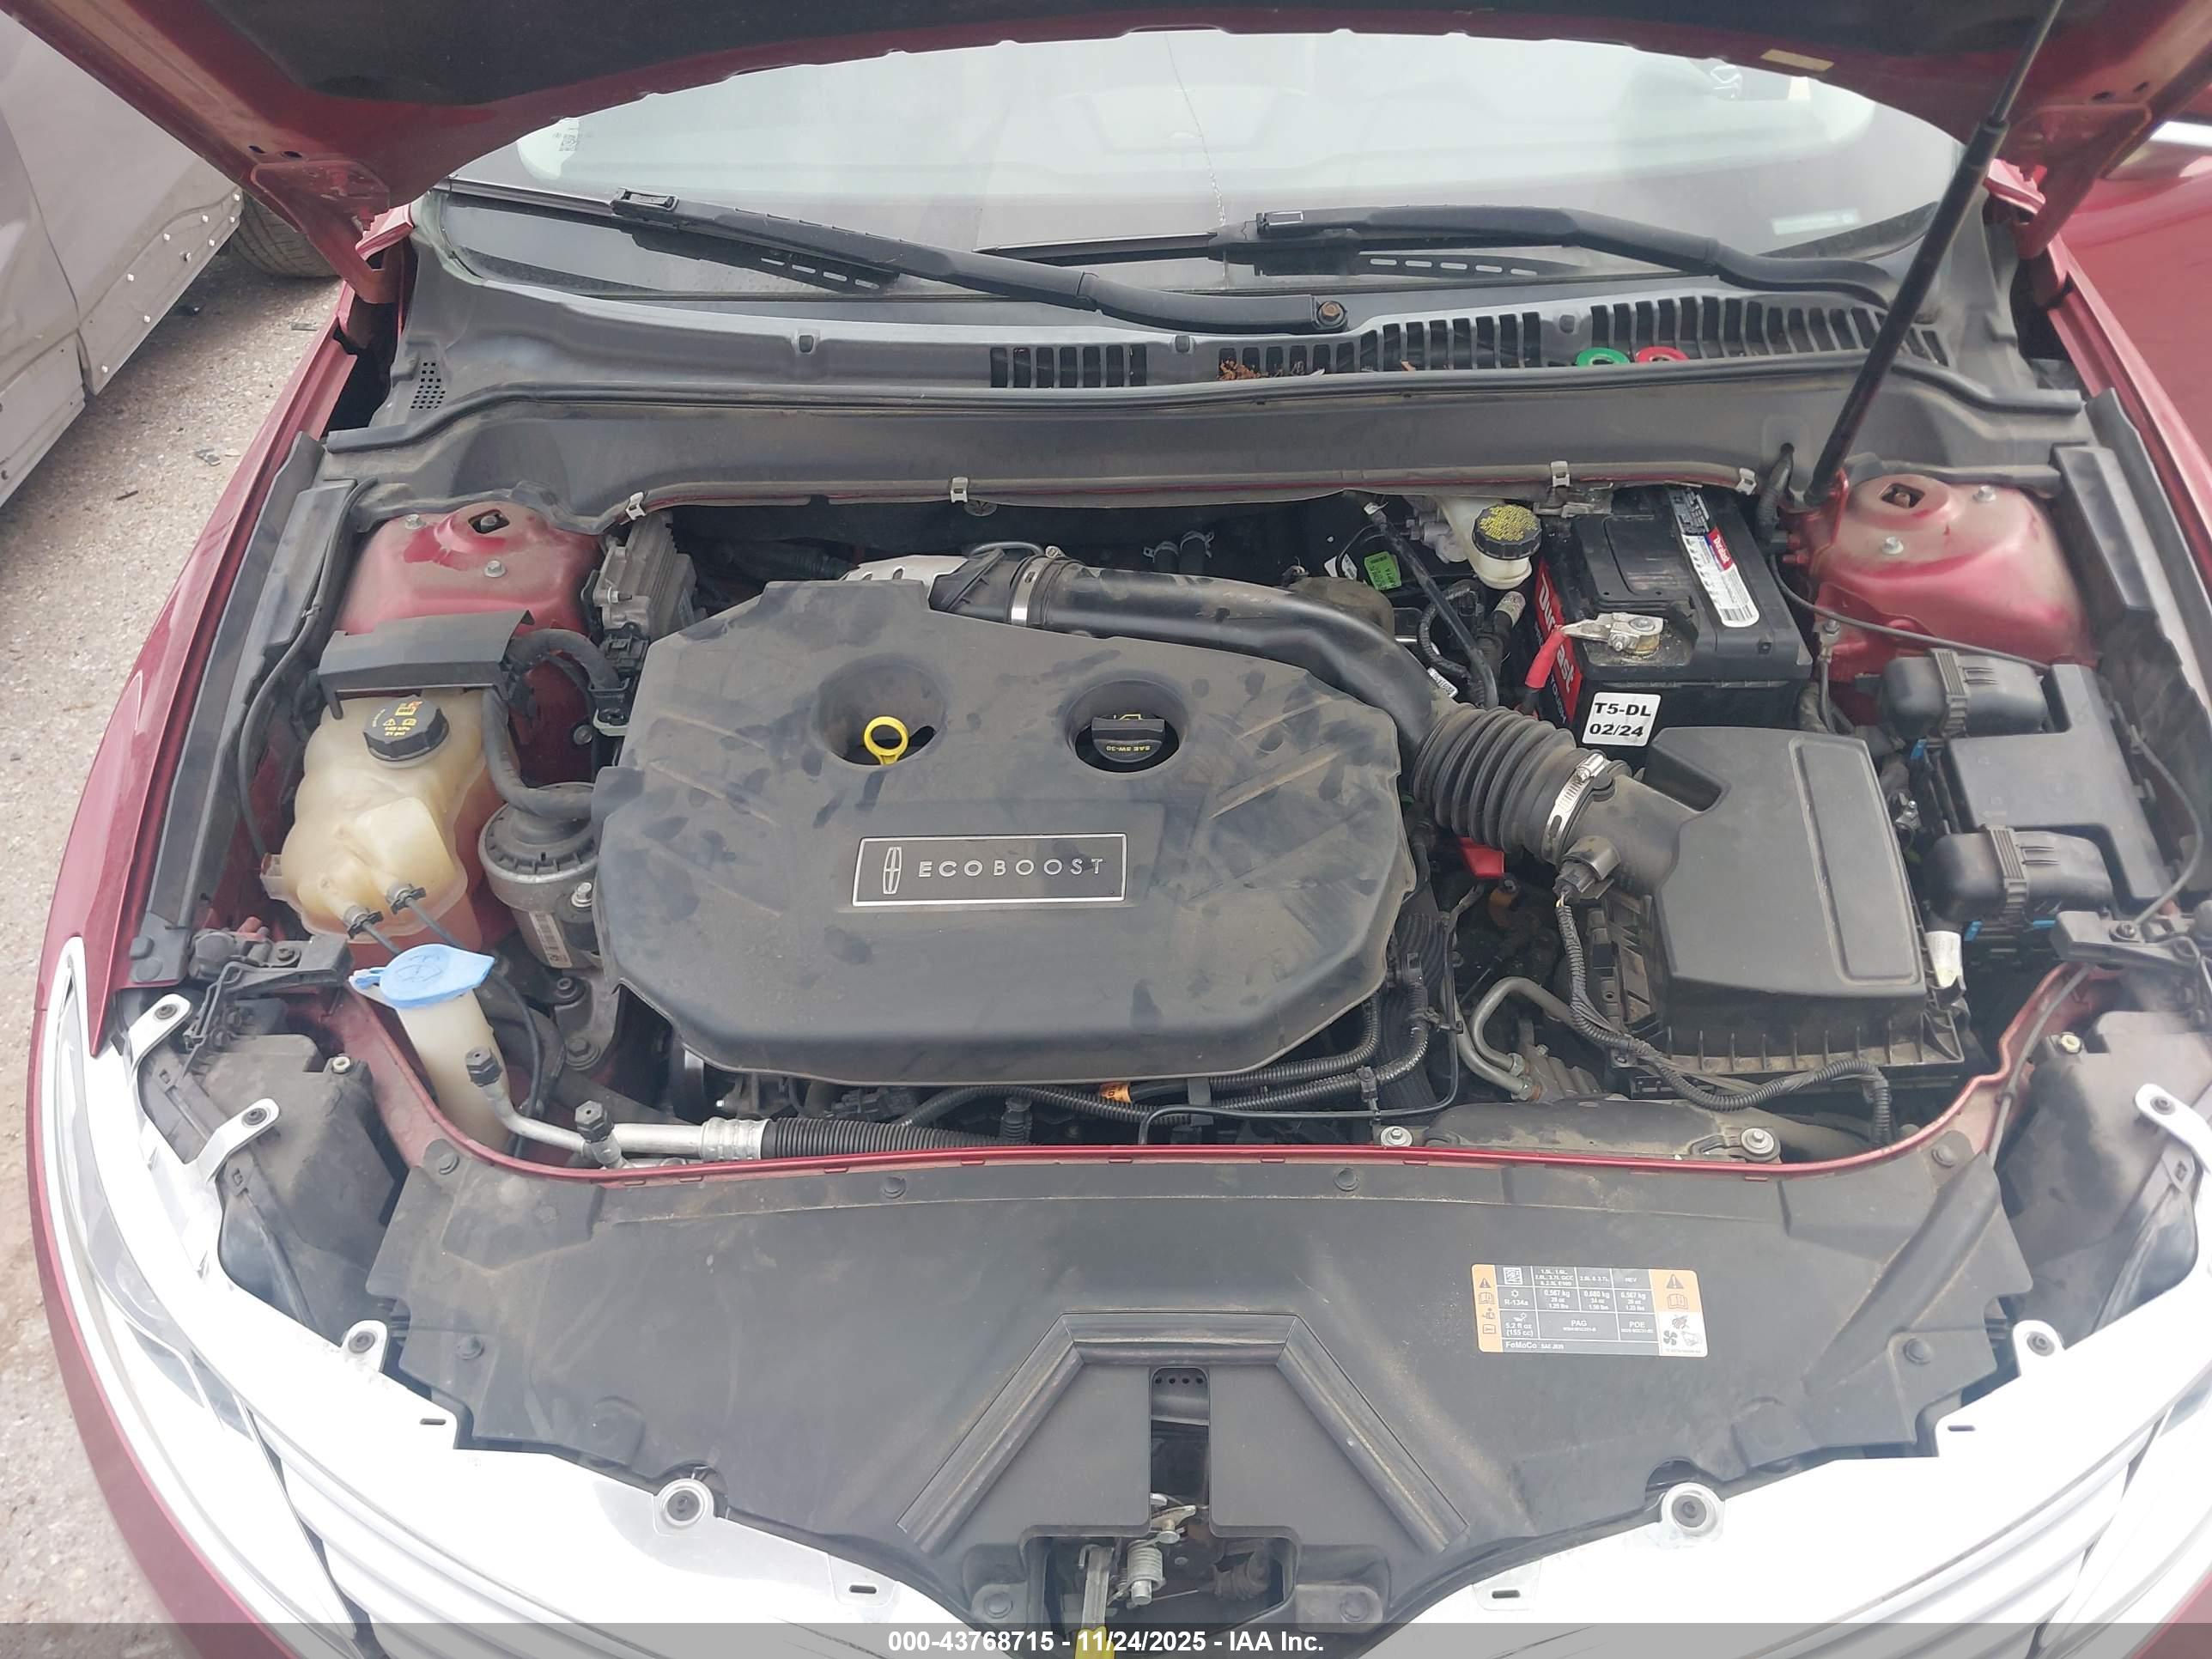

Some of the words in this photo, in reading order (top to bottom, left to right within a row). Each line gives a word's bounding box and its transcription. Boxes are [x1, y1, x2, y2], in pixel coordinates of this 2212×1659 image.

[1539, 572, 1576, 695] Durast
[1594, 701, 1652, 718] T5-DL
[1589, 722, 1644, 738] 02/24
[917, 858, 1104, 878] ECOBOOST
[1601, 1291, 1610, 1299] kg
